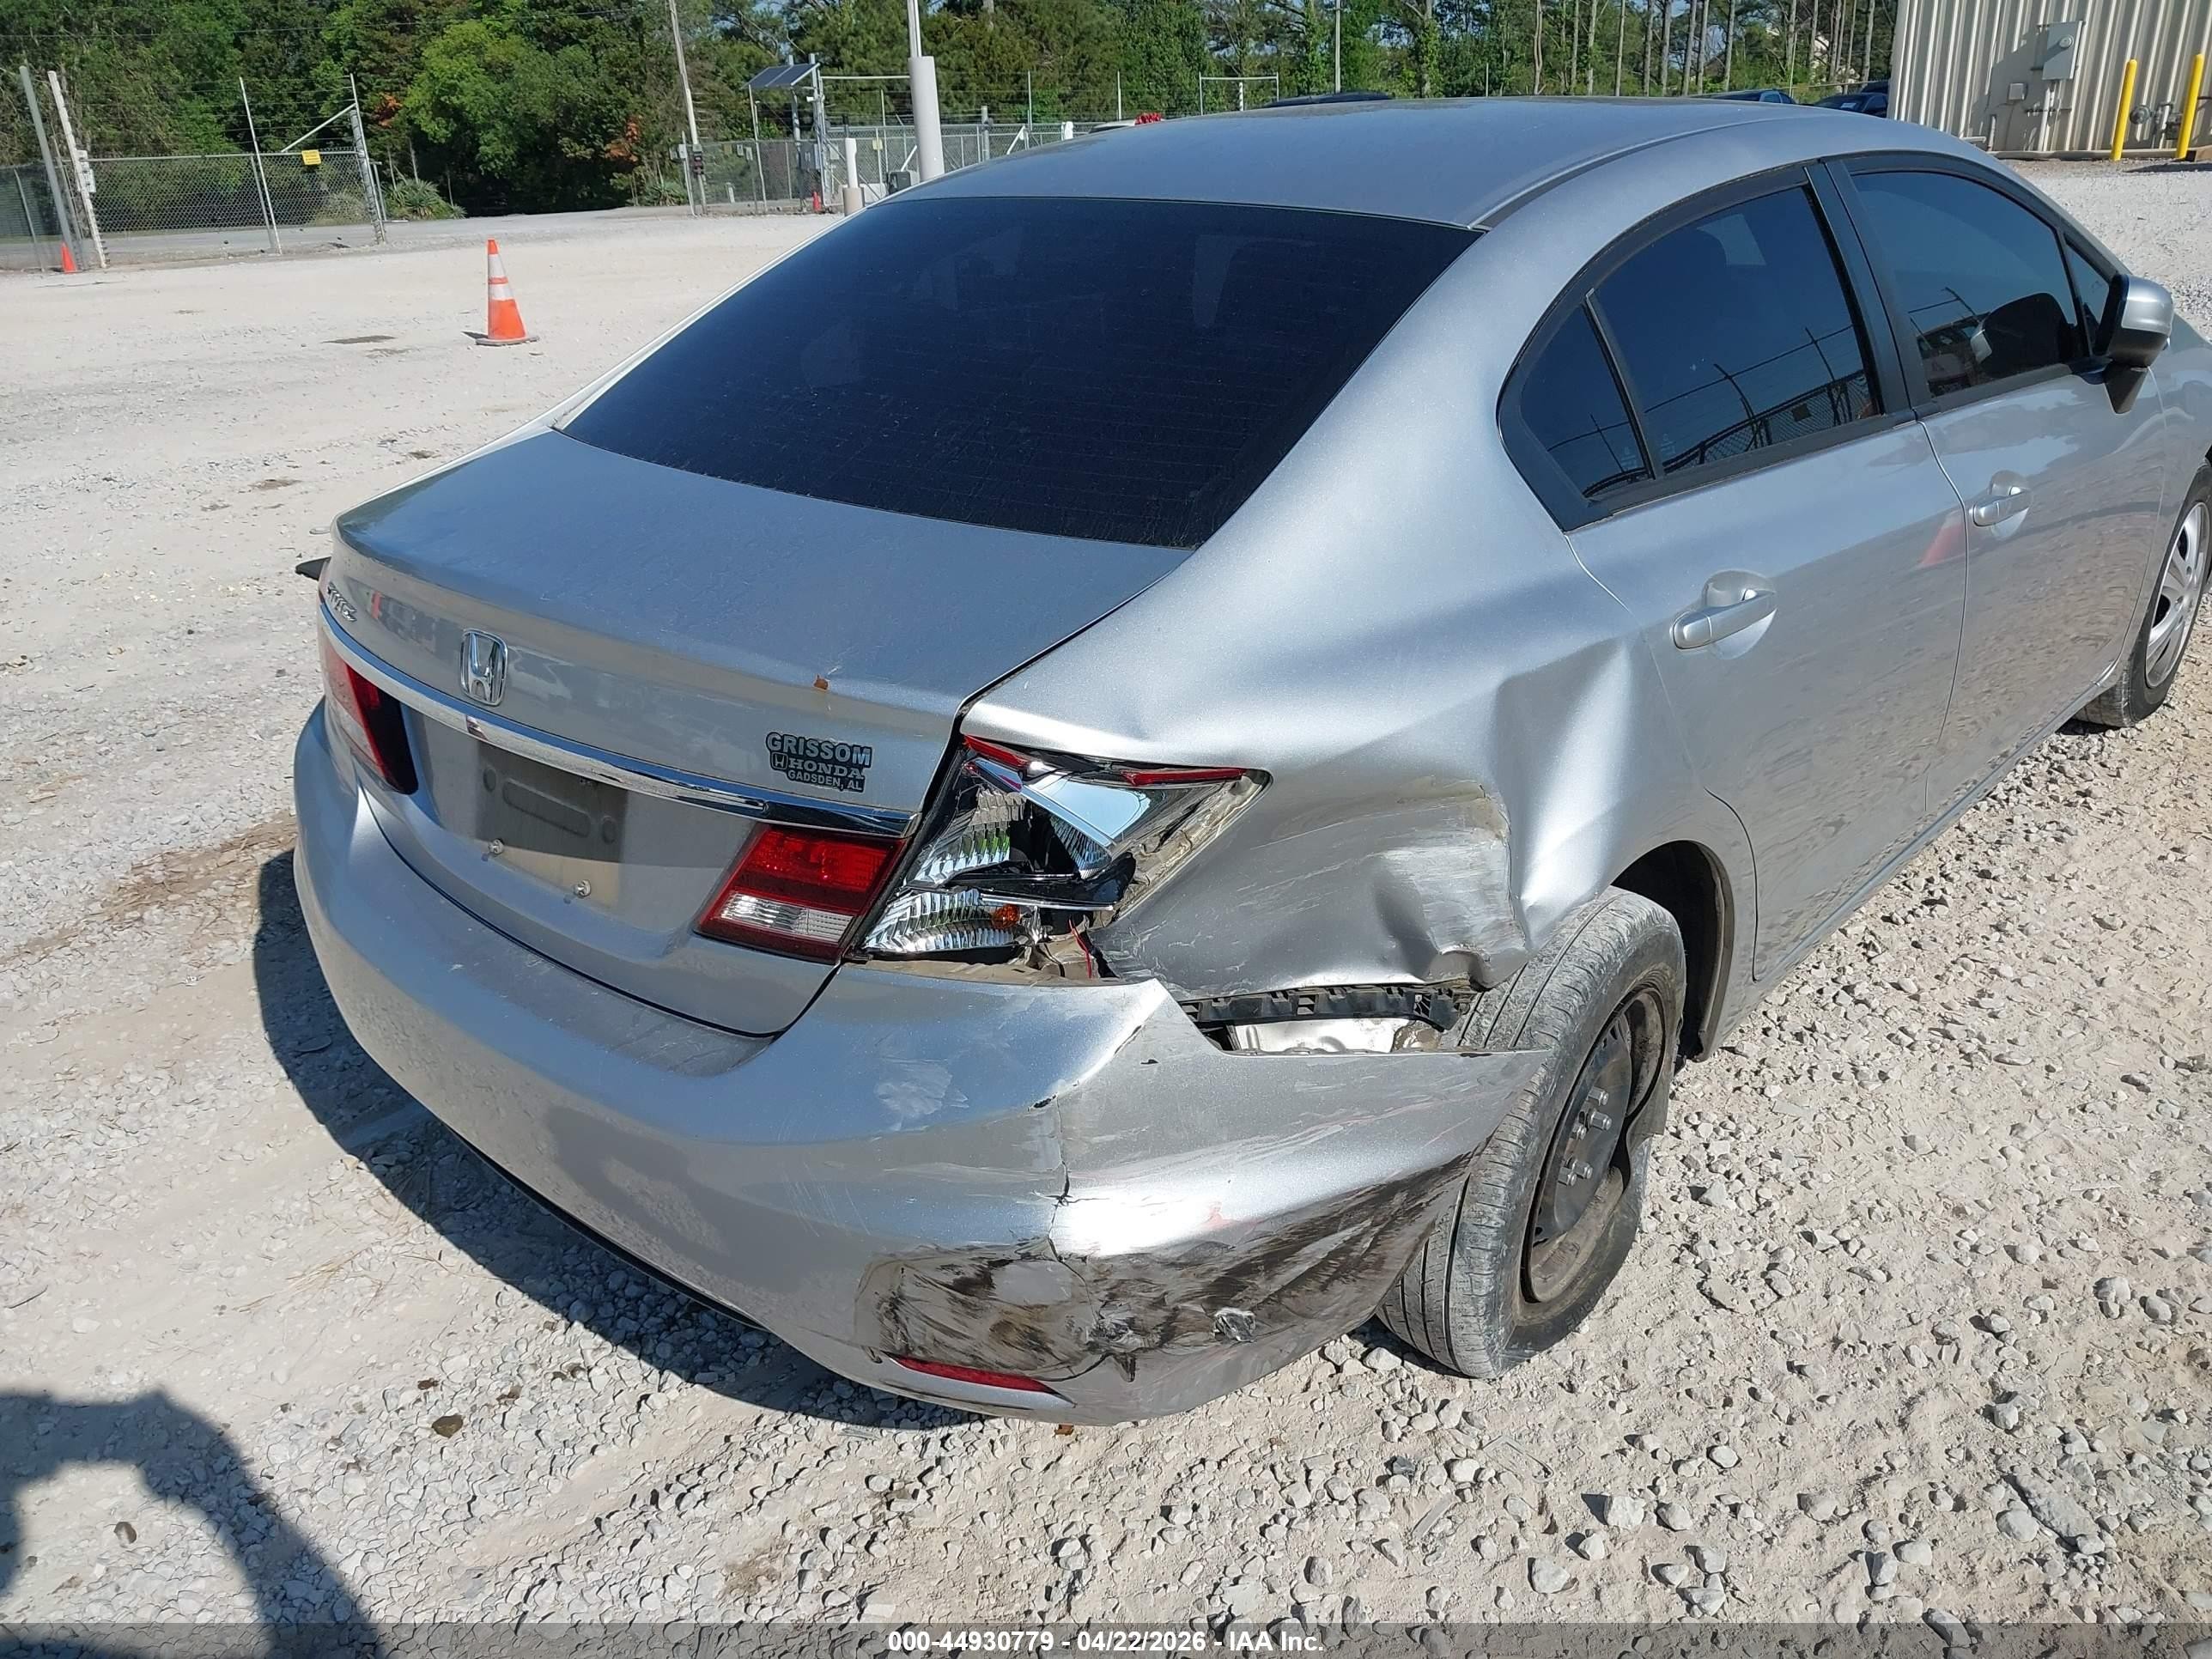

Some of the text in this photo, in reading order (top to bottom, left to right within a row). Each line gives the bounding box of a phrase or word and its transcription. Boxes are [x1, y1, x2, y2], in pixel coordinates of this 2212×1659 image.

[767, 732, 871, 766] GRISSOM
[787, 769, 862, 790] GADSDEN, AL
[788, 757, 864, 780] HONDA
